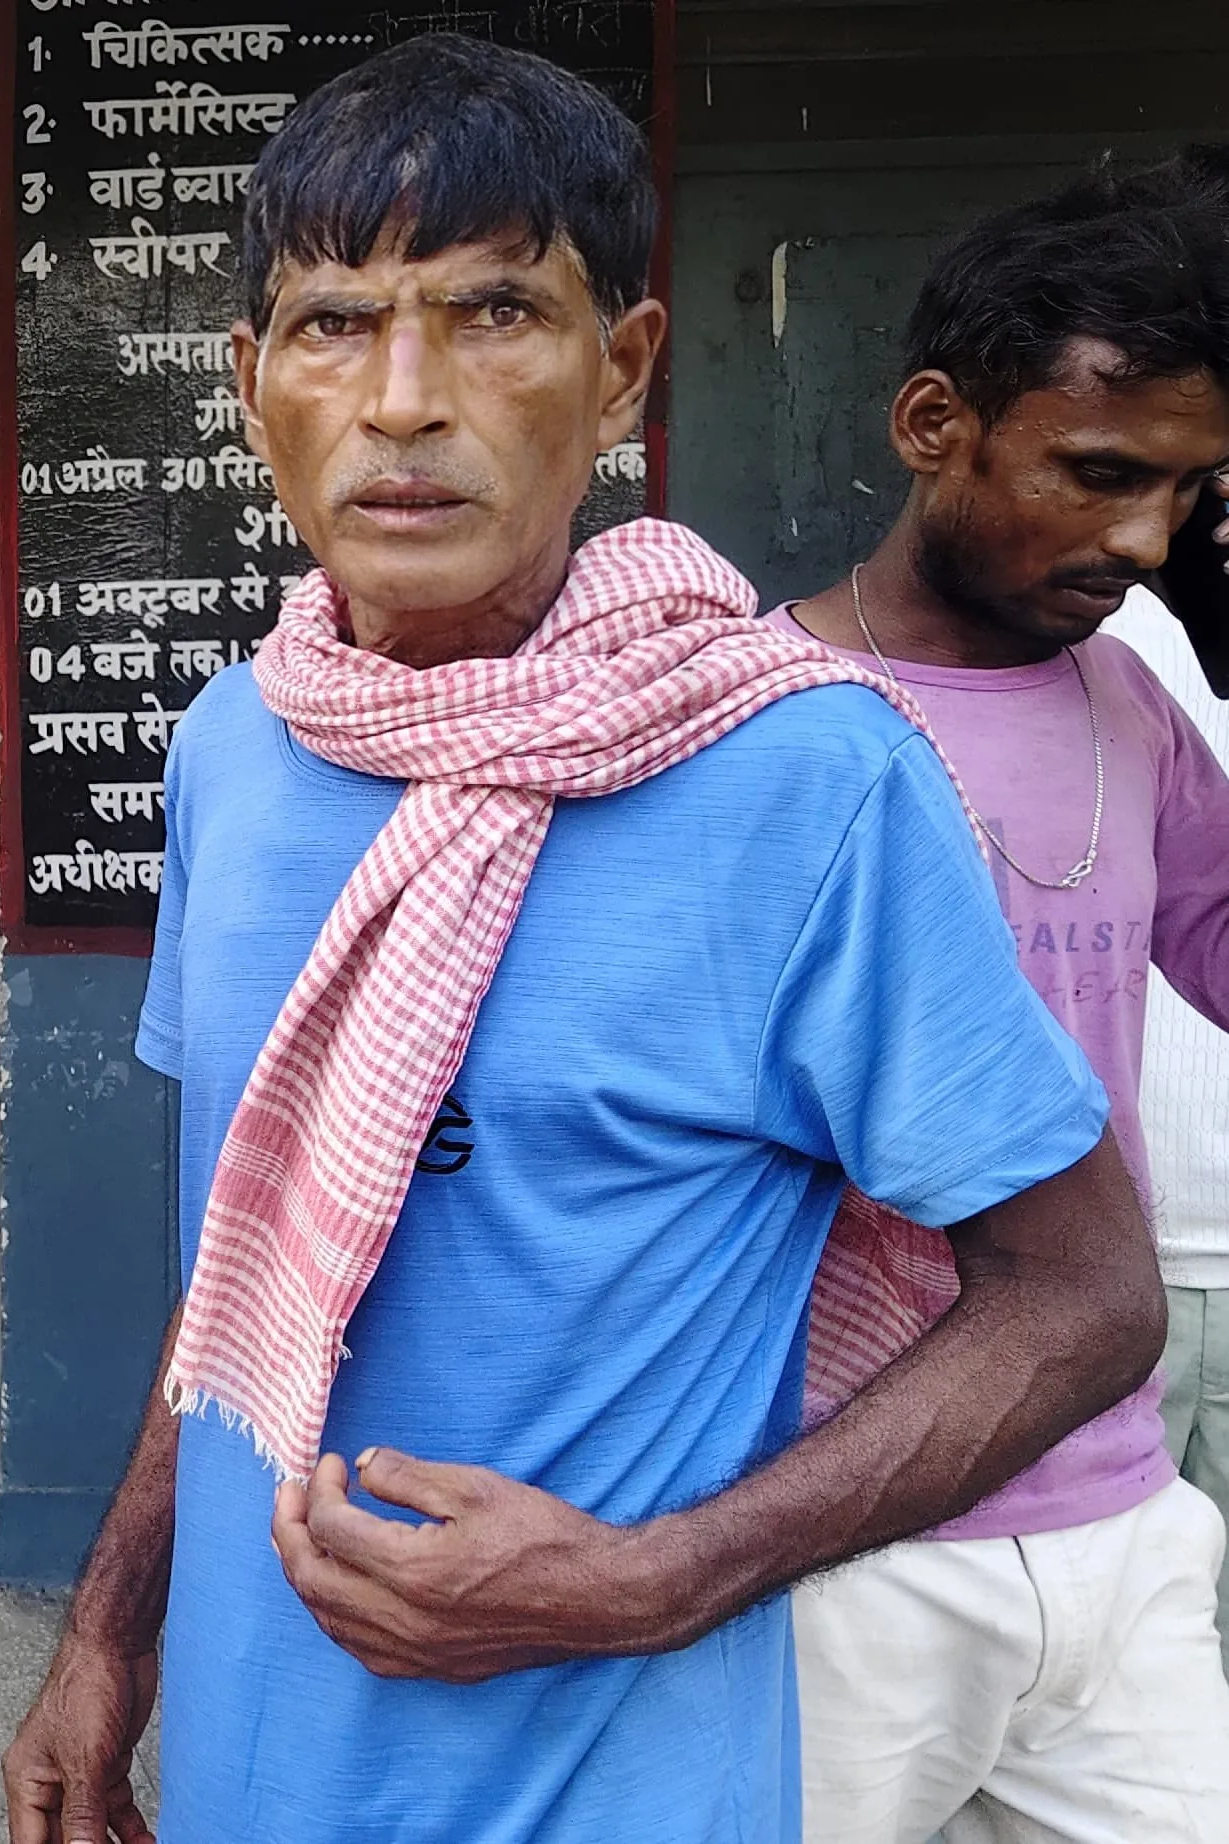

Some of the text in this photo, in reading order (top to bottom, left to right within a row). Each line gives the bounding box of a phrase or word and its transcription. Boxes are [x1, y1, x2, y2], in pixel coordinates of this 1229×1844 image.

[81, 19, 291, 69] चिकित्सक
[89, 216, 231, 279] स्वीपर
[118, 332, 234, 377] अस्पता
[24, 582, 62, 618] 01
[230, 562, 270, 612] से
[30, 645, 86, 683] 04
[89, 629, 161, 682] बजे
[28, 712, 129, 755] प्रसव
[132, 692, 185, 755] से
